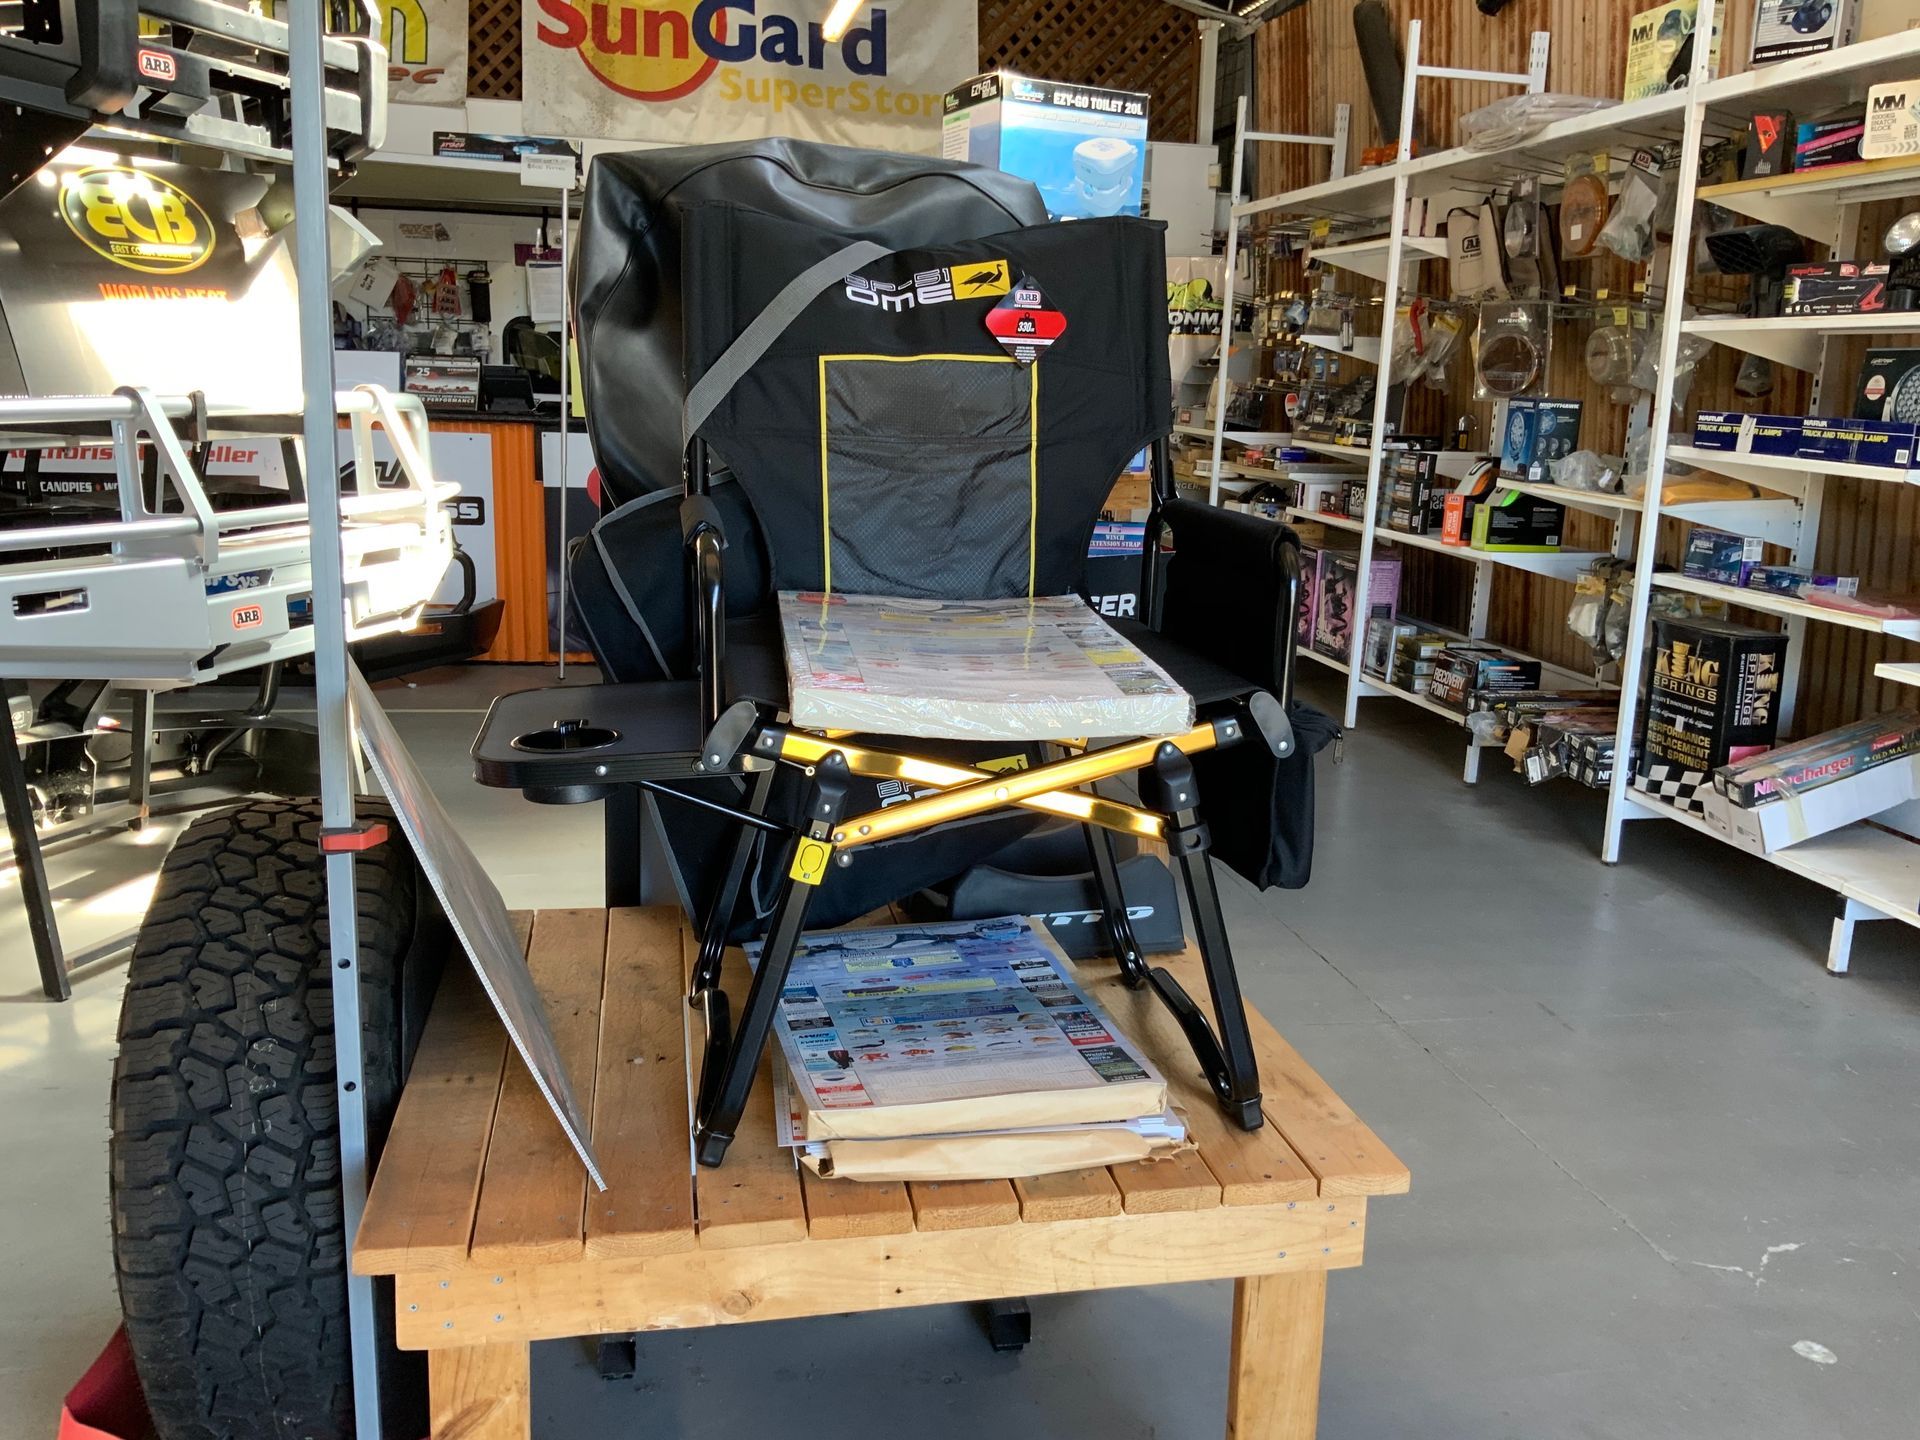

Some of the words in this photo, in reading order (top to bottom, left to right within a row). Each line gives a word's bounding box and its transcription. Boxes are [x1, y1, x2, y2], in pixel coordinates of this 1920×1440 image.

[537, 0, 887, 76] SunGard
[144, 56, 171, 74] ARB
[718, 67, 943, 117] SuperStor
[1053, 92, 1089, 108] EZY-GO
[1090, 97, 1123, 113] TOILET
[1124, 101, 1144, 115] 20L
[79, 174, 197, 244] ECB
[1018, 293, 1038, 302] ARB
[416, 367, 431, 377] 25
[1697, 424, 1718, 433] TRUCK
[1718, 425, 1731, 433] AND
[1759, 428, 1782, 437] LAMPS
[1802, 429, 1822, 437] TRUCK
[1822, 430, 1836, 439] AND
[1836, 431, 1864, 441] TRAILER
[1864, 434, 1889, 443] LAMPS
[40, 481, 93, 493] CANOPIES
[236, 610, 260, 625] ARB
[1433, 666, 1466, 690] RECOVERY
[1652, 675, 1718, 702] SPRINGS
[1742, 653, 1757, 726] SPRINGS
[1430, 680, 1450, 700] POINT
[1648, 718, 1711, 748] PERFORMANCE
[1646, 741, 1664, 756] COIL
[1666, 748, 1709, 771] SPRINGS
[1647, 730, 1711, 760] REPLACEMENT
[1872, 751, 1888, 761] OLD
[1888, 744, 1908, 755] MAN
